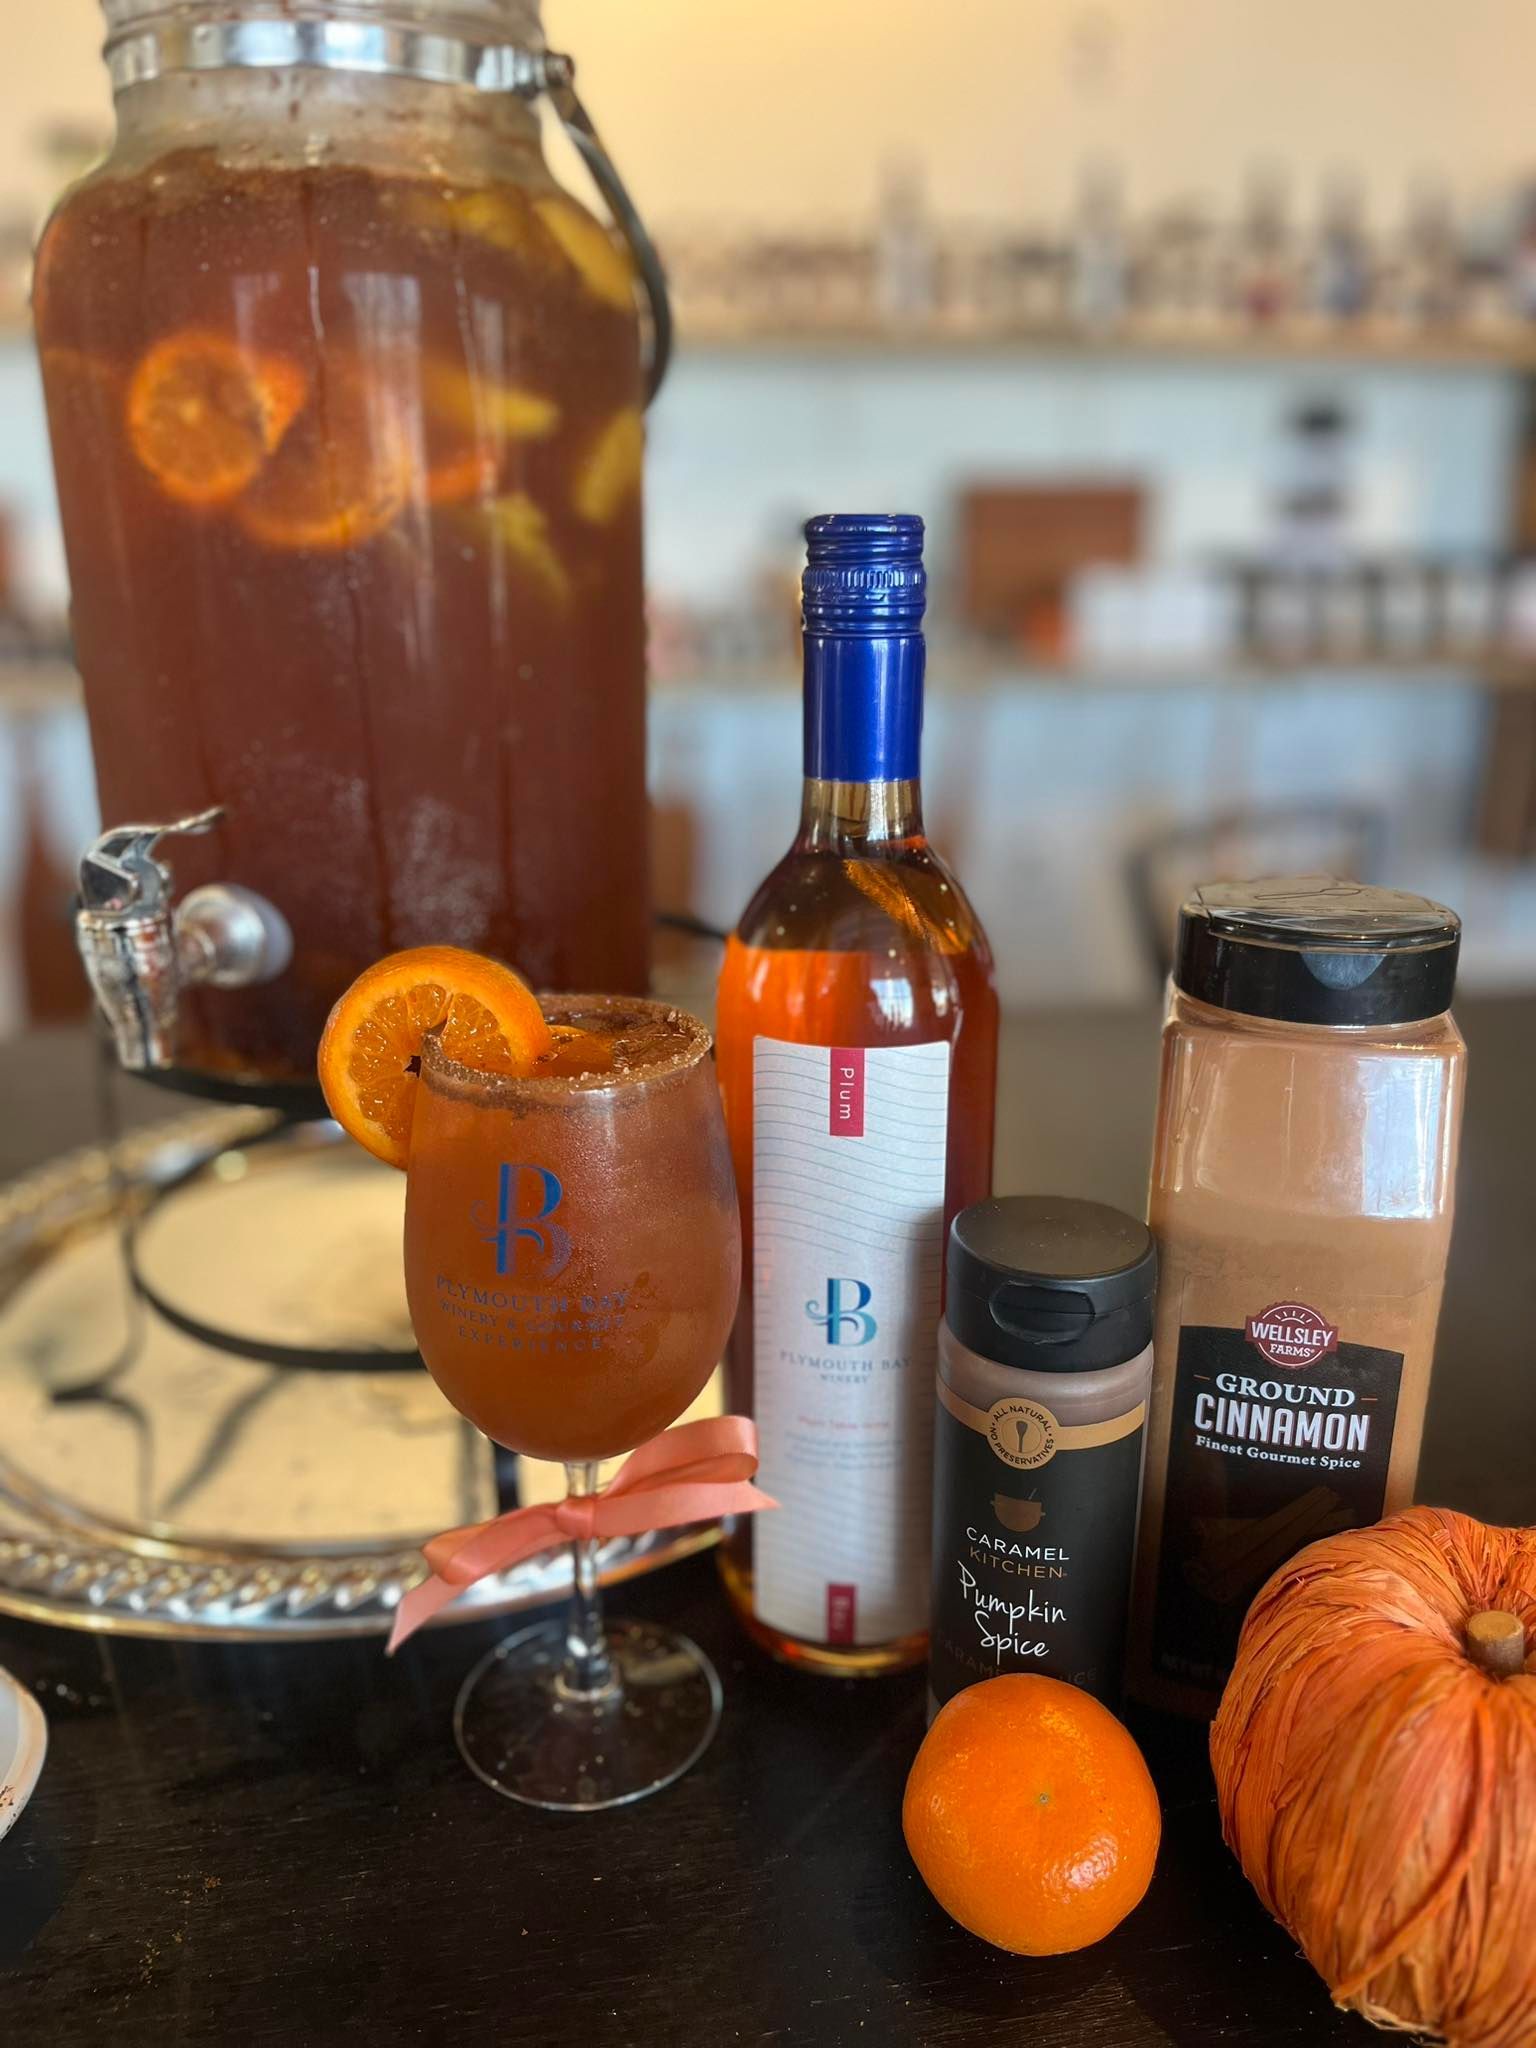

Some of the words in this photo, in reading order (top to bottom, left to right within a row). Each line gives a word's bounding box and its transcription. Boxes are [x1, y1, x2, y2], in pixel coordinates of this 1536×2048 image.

[839, 1067, 855, 1120] Plum
[437, 1274, 568, 1313] PLYMOUTH
[580, 1291, 630, 1312] BAY
[441, 1299, 498, 1327] WINERY
[1251, 1321, 1334, 1347] WELLSLEY
[1269, 1343, 1312, 1358] FARMS
[780, 1351, 873, 1371] PLYMOUTH
[881, 1357, 911, 1370] BAY
[1215, 1373, 1356, 1407] GROUND
[993, 1405, 1008, 1422] ALL
[1009, 1405, 1052, 1432] NATURAL
[1193, 1393, 1371, 1452] CINNAMON
[989, 1427, 998, 1441] NO
[995, 1438, 1055, 1465] PRESERVATIVES
[1195, 1435, 1243, 1456] Finest
[1246, 1447, 1317, 1466] Gourmet
[1319, 1456, 1361, 1470] Spice
[966, 1526, 1070, 1561] CARAMEL
[969, 1546, 1064, 1579] KITCHEN
[957, 1560, 1067, 1635] Pumpkin
[974, 1610, 1050, 1666] Spice
